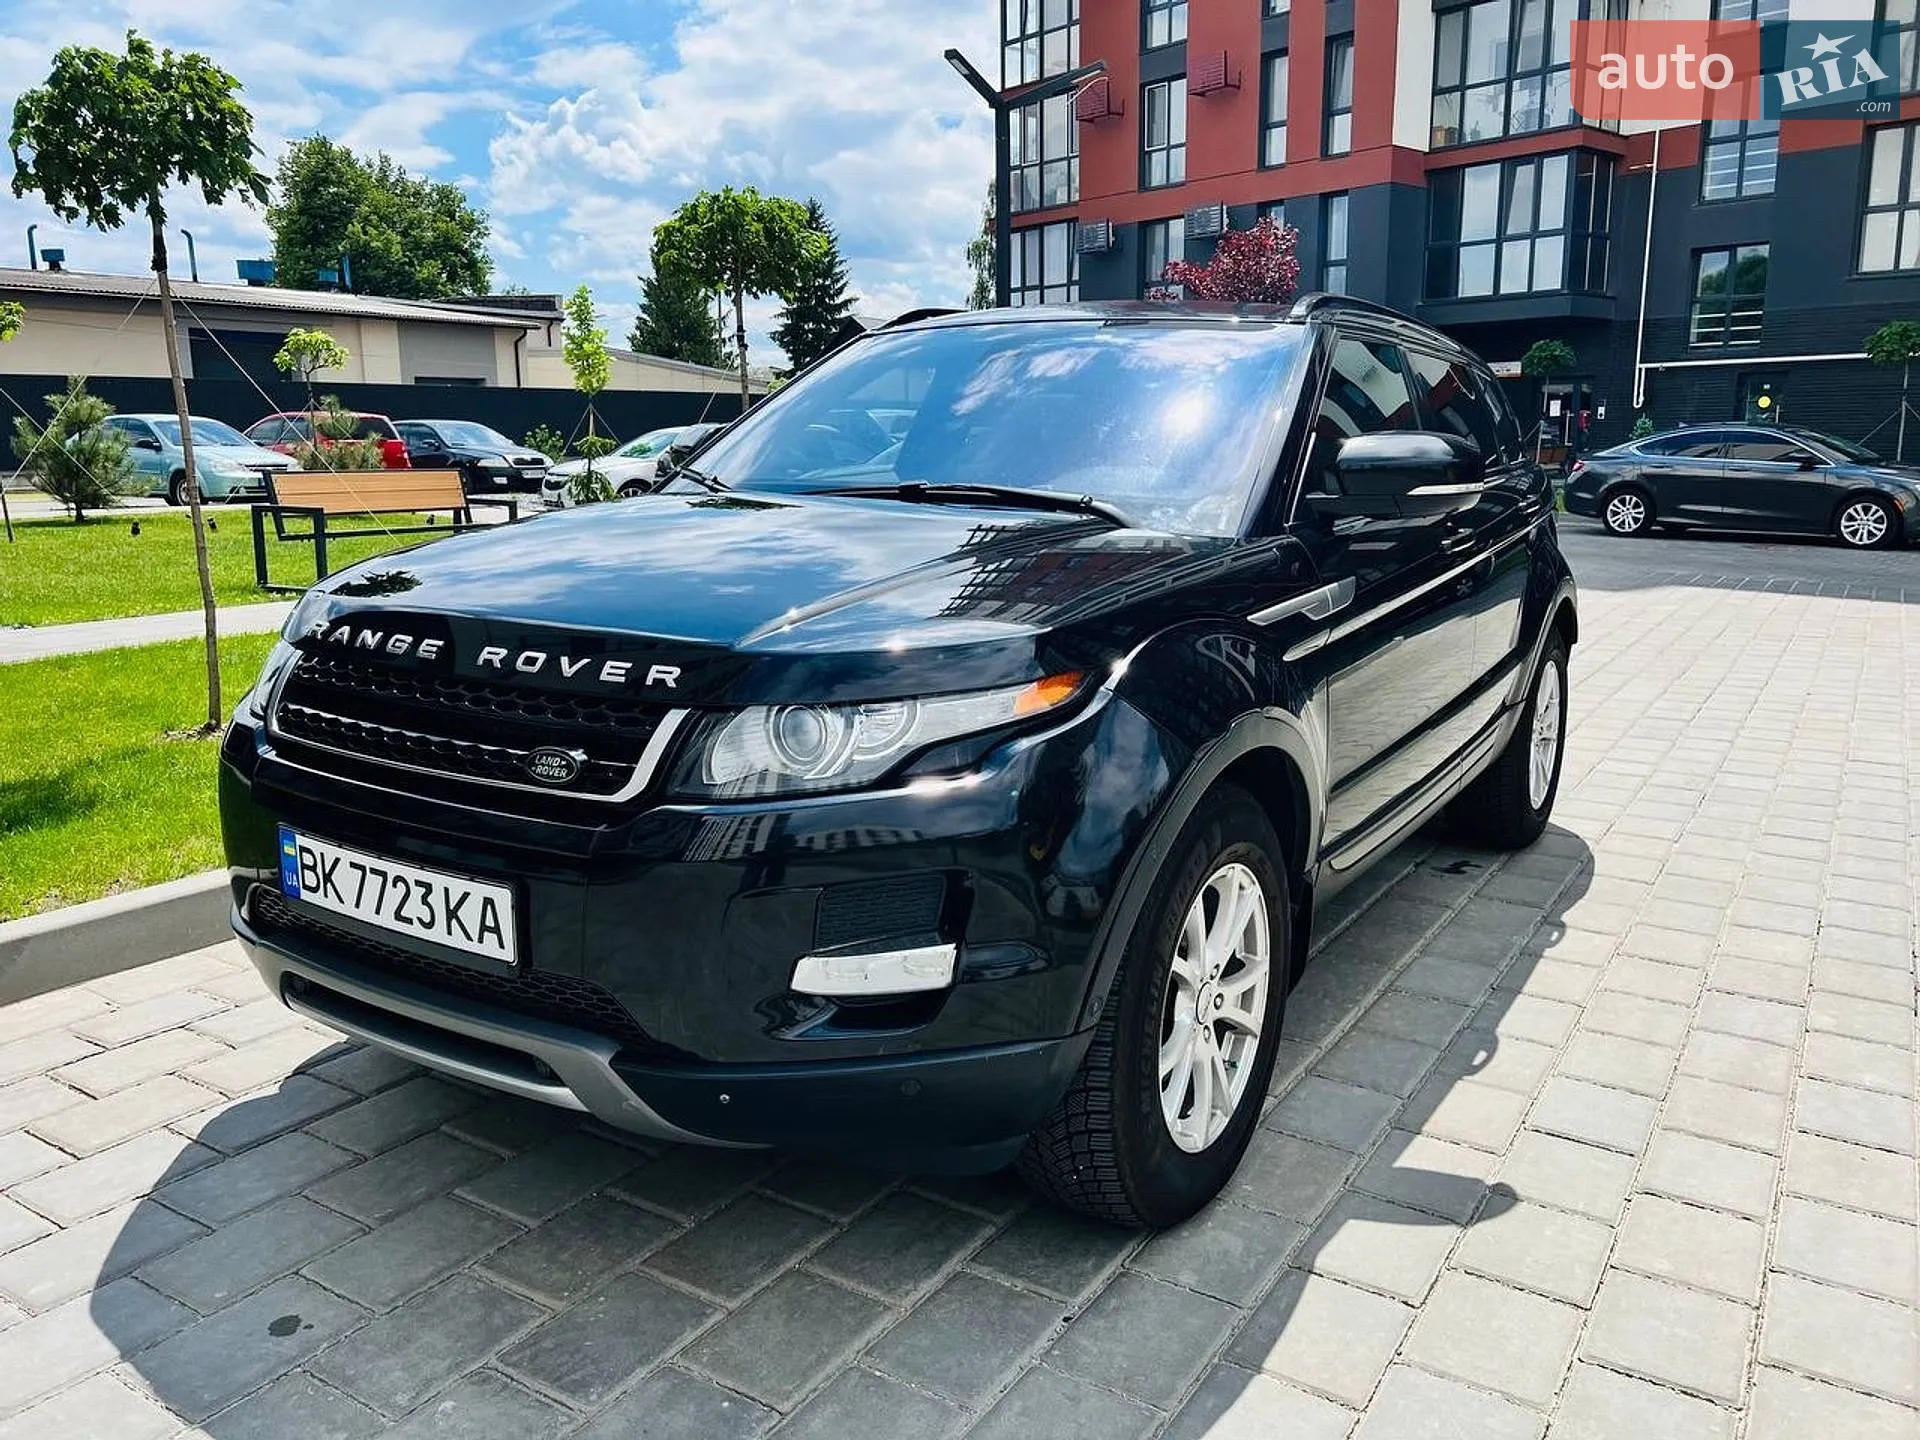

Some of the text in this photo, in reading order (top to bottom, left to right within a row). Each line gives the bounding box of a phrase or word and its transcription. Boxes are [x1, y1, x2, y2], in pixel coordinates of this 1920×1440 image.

[305, 620, 681, 688] RANGE ROVER
[286, 870, 299, 888] UA
